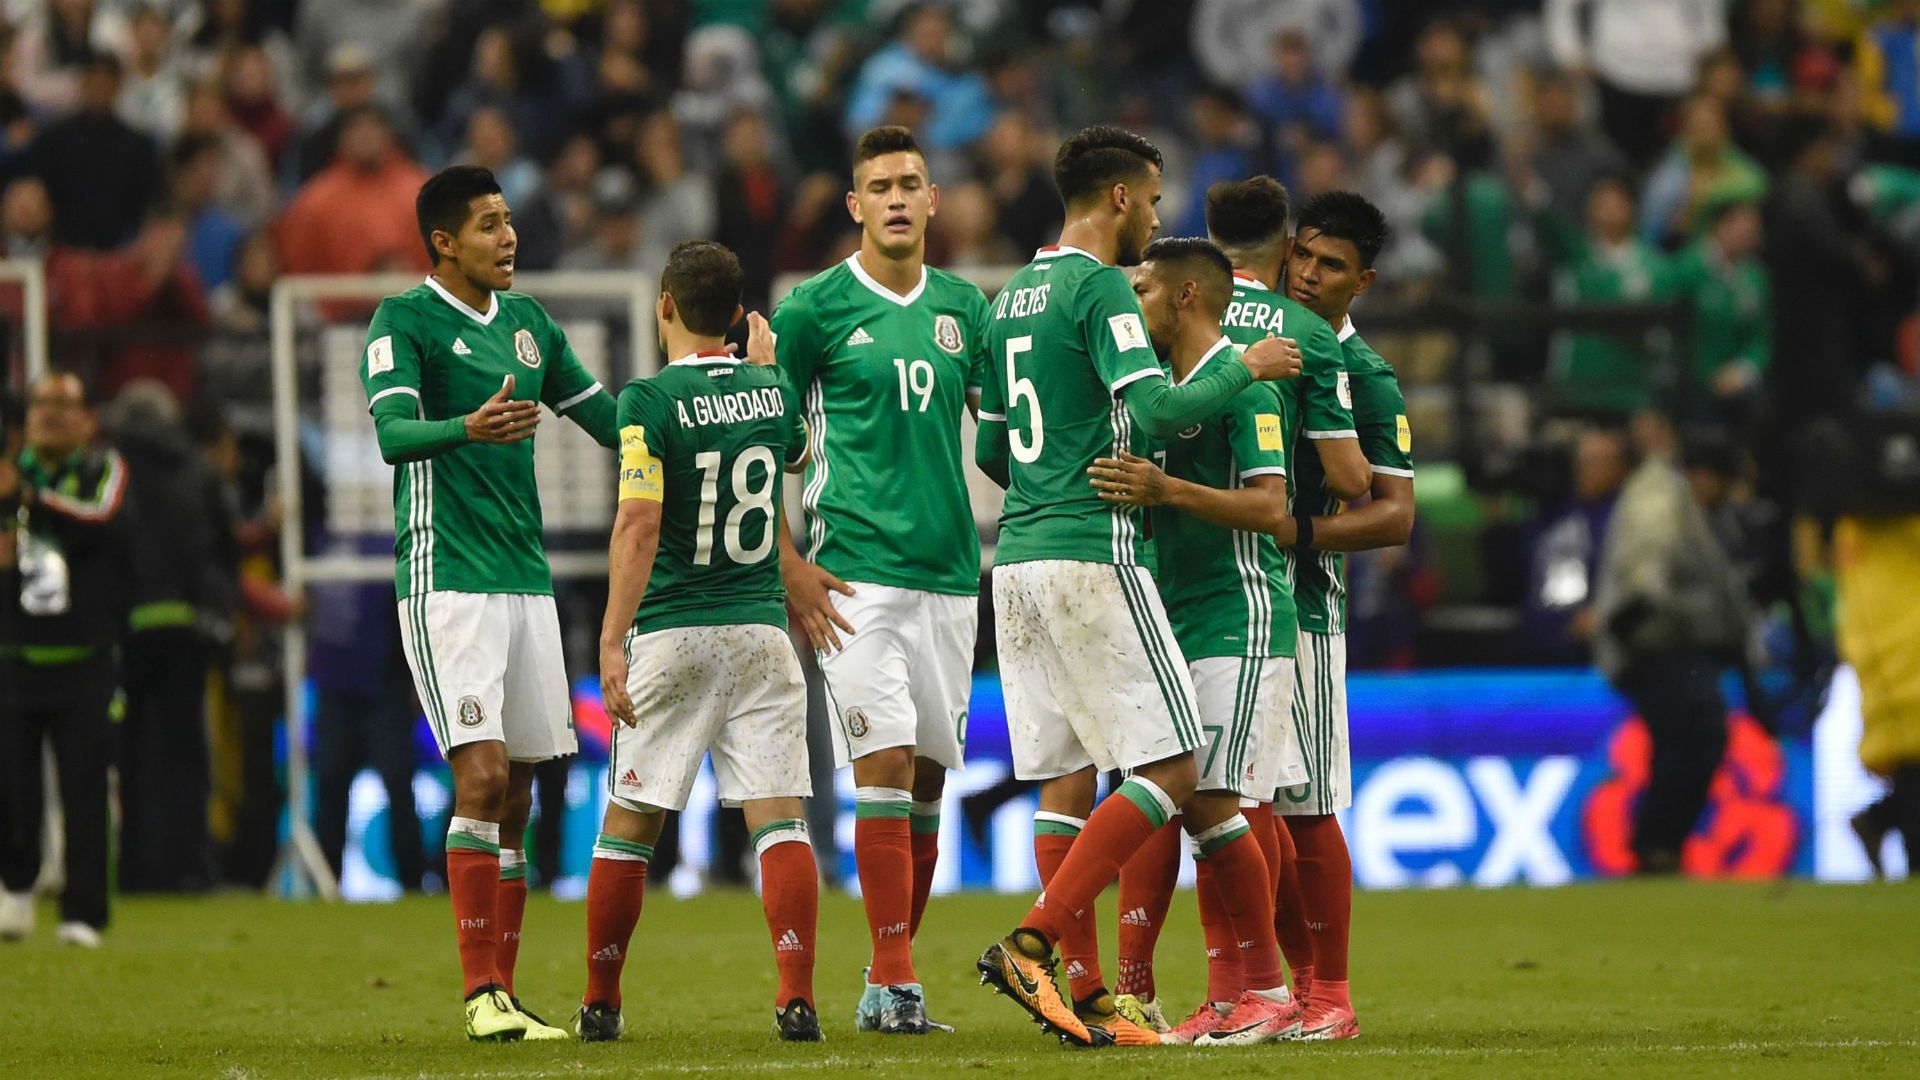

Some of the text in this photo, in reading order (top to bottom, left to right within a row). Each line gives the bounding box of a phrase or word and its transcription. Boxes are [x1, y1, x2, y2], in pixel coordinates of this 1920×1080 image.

[995, 283, 1051, 320] D. REYES
[1219, 302, 1284, 335] RERA
[893, 358, 935, 412] 19
[1006, 335, 1044, 463] 5
[676, 387, 785, 429] A. GUARDADO
[693, 445, 776, 566] 18
[1202, 725, 1224, 779] 7
[460, 918, 490, 930] FMF
[503, 931, 521, 942] FM
[878, 922, 908, 939] FMF
[1120, 917, 1151, 928] adidas
[777, 943, 804, 951] adidas
